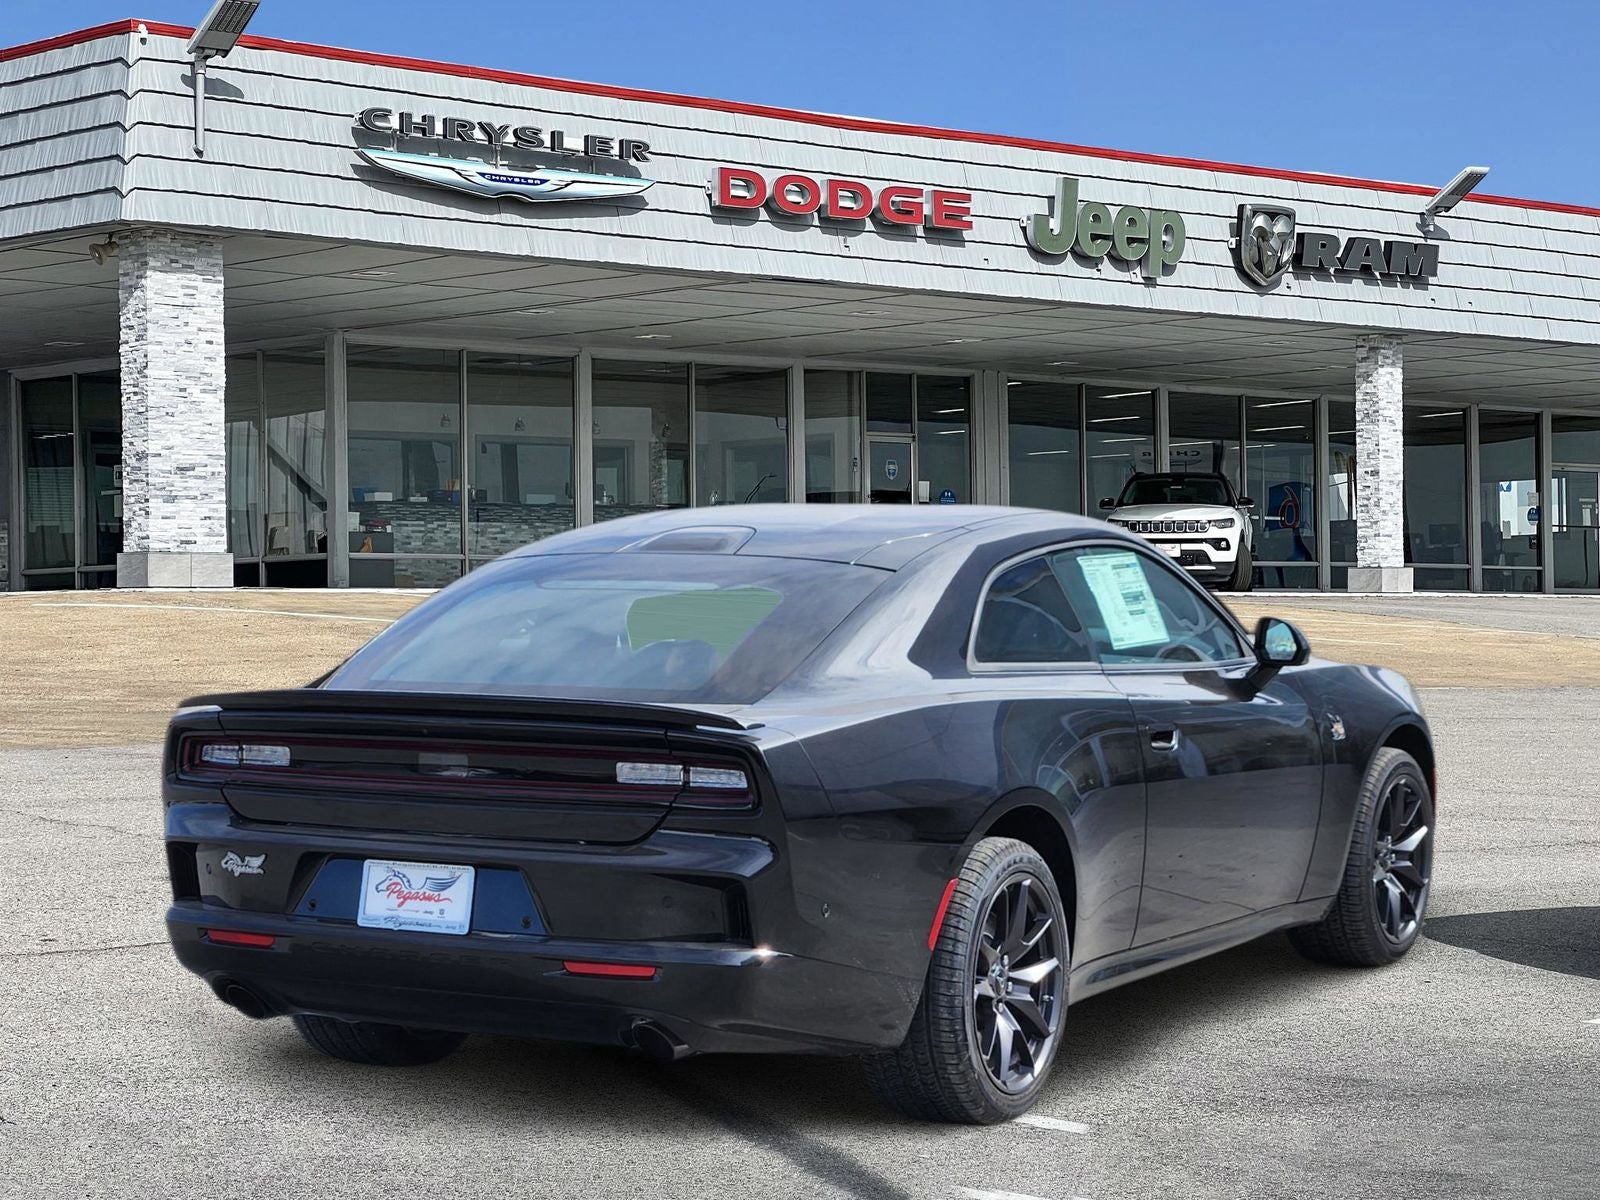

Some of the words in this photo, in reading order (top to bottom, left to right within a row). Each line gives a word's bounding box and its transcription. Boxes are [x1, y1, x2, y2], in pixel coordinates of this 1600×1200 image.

[357, 106, 650, 163] CHRYSLER
[484, 174, 541, 185] CHRYSLER
[713, 166, 973, 230] DODGE
[1027, 177, 1186, 278] Jeep
[1299, 232, 1439, 277] RAM
[386, 881, 453, 908] Pegasus
